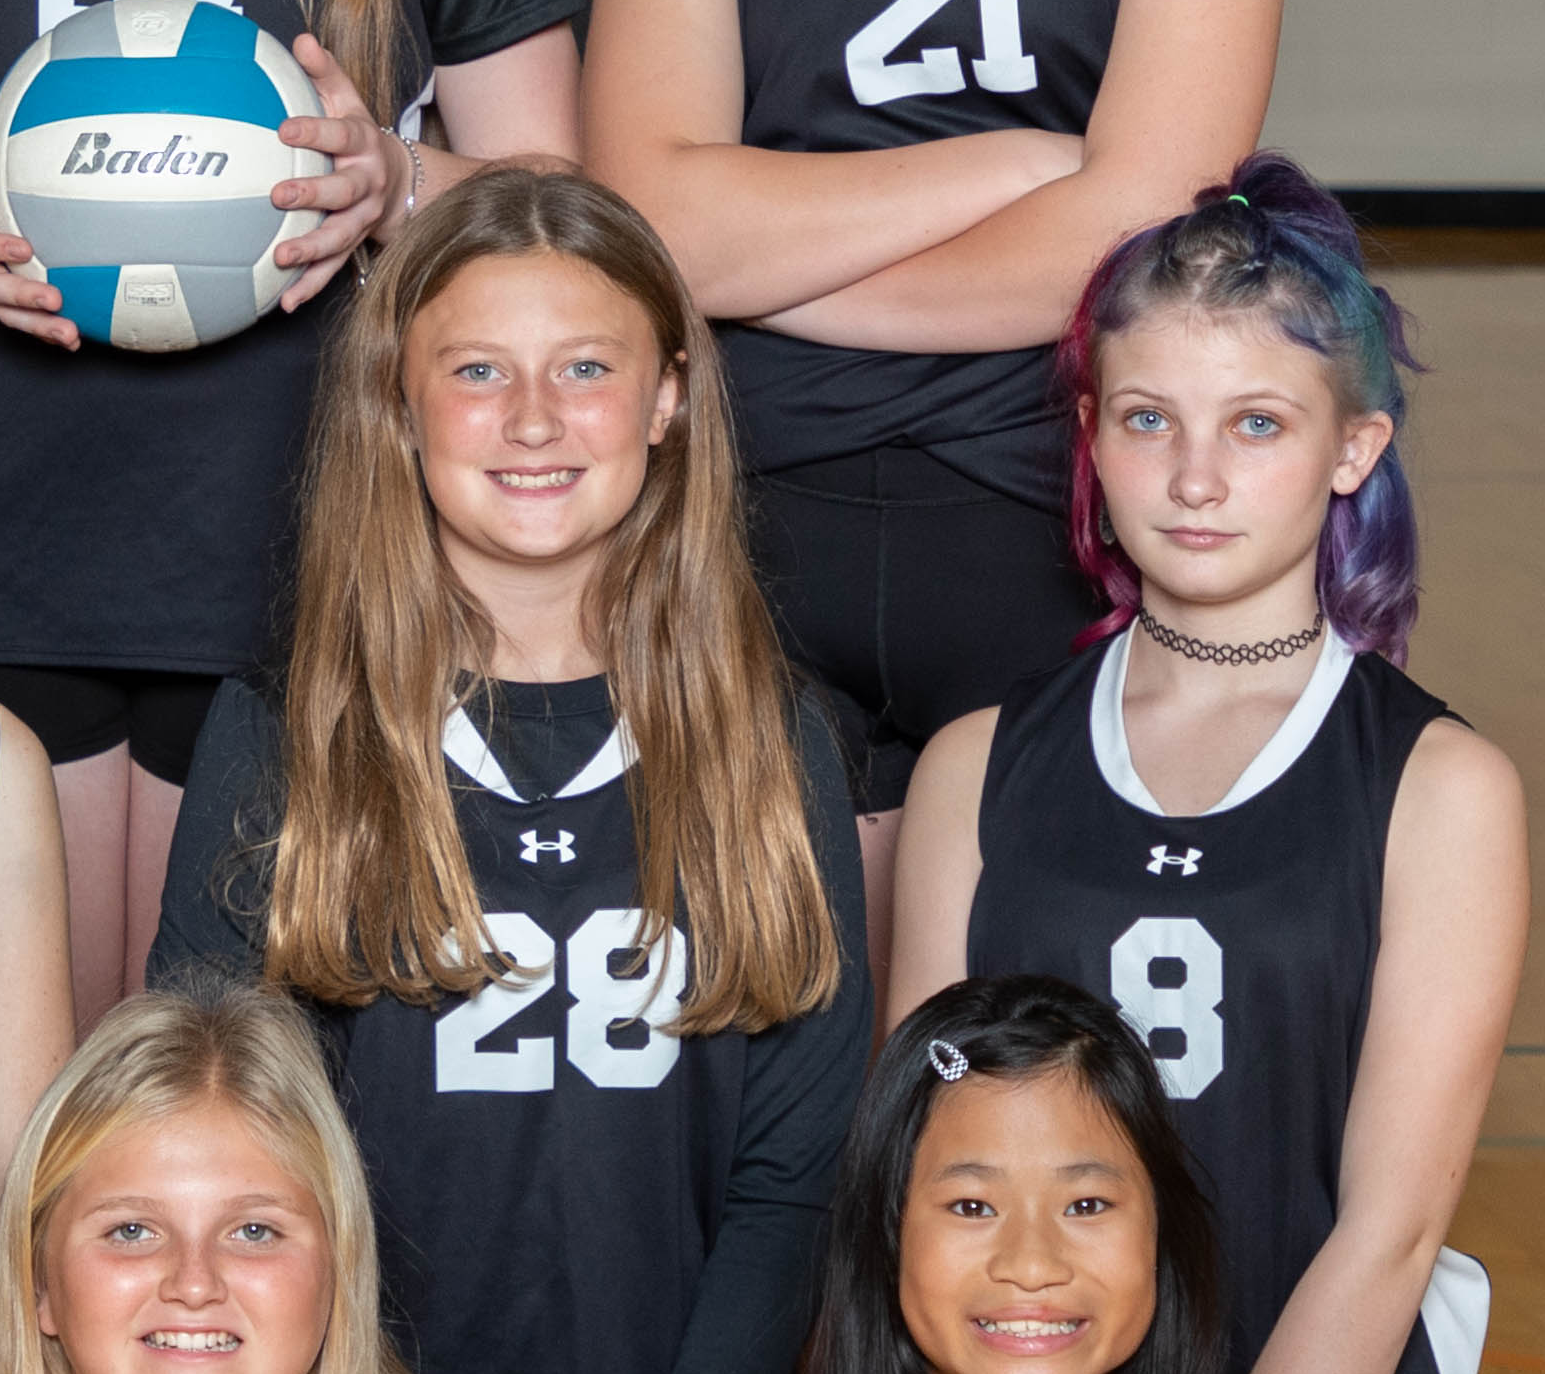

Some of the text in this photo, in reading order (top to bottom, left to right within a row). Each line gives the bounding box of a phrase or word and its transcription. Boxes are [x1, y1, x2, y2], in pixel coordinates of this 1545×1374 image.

[61, 132, 229, 177] Baden
[435, 908, 687, 1093] 28
[1110, 917, 1224, 1100] 8
